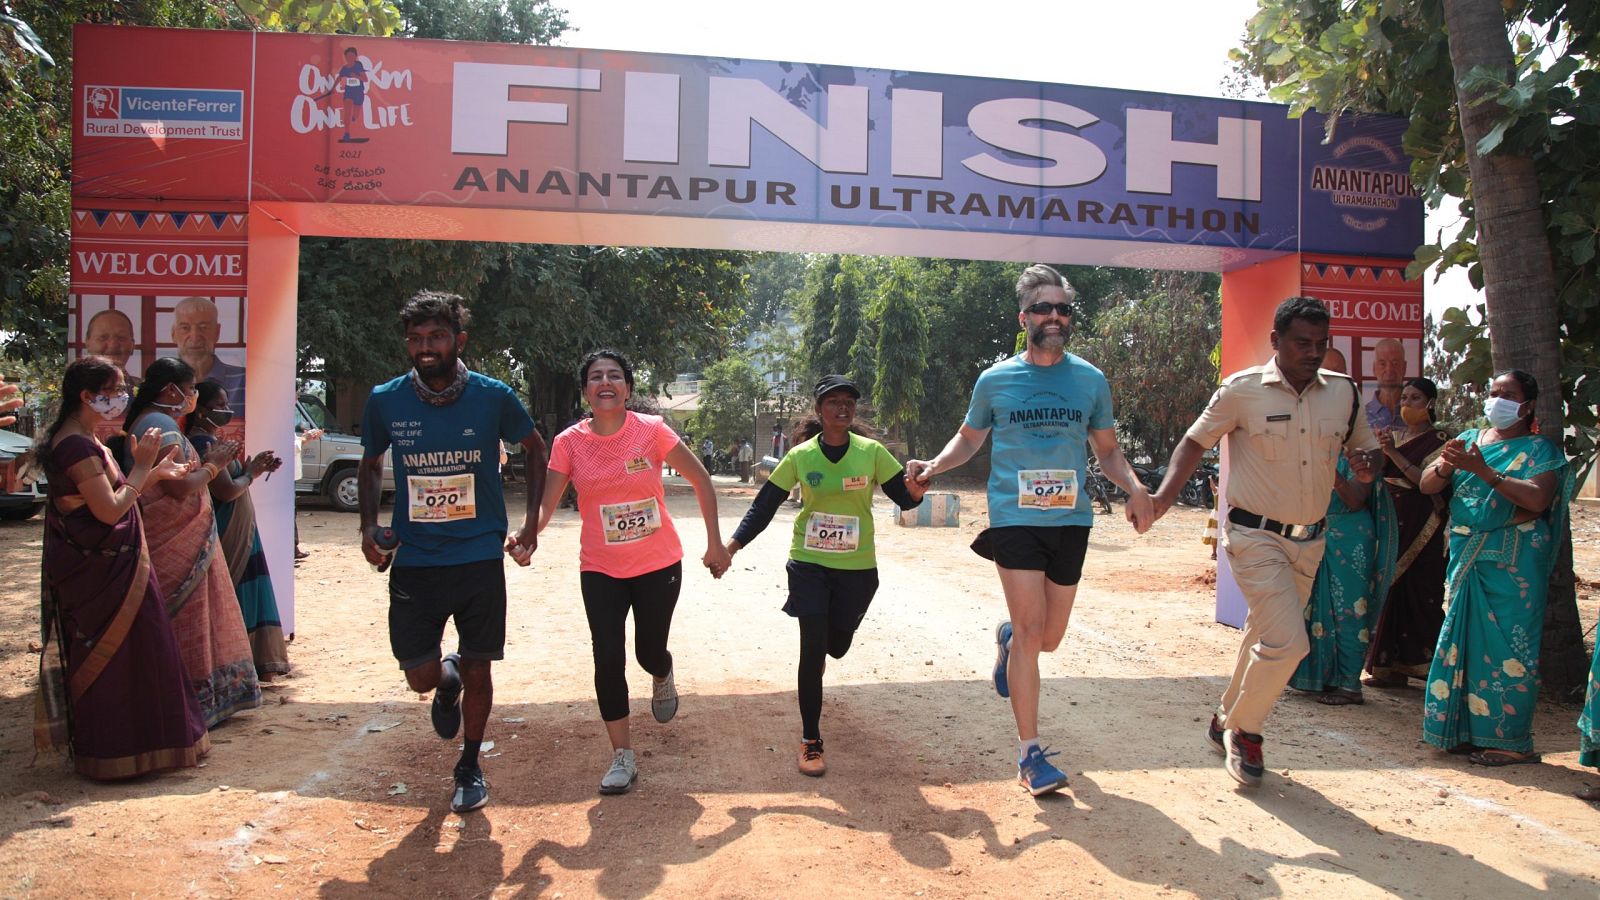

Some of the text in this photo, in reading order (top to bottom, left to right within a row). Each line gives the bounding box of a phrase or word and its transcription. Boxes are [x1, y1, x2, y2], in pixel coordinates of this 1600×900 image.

[126, 96, 236, 113] VicenteFerrer
[86, 123, 241, 137] Rural Development Trust
[451, 62, 1263, 202] FINISH
[339, 150, 363, 159] 2021
[452, 166, 1261, 234] ANANTAPUR ULTRAMARATHON
[1333, 194, 1397, 209] ULTRAMARATHON
[77, 251, 242, 277] WELCOME
[1009, 407, 1082, 424] ANANTAPUR
[1023, 421, 1069, 429] ULTRAMARATHON
[406, 429, 423, 437] LIFE
[402, 450, 481, 468] ANANTAPUR
[417, 464, 466, 475] ULTRAMARATHON
[1035, 485, 1064, 497] 047
[426, 493, 458, 506] 020
[617, 516, 646, 530] 052
